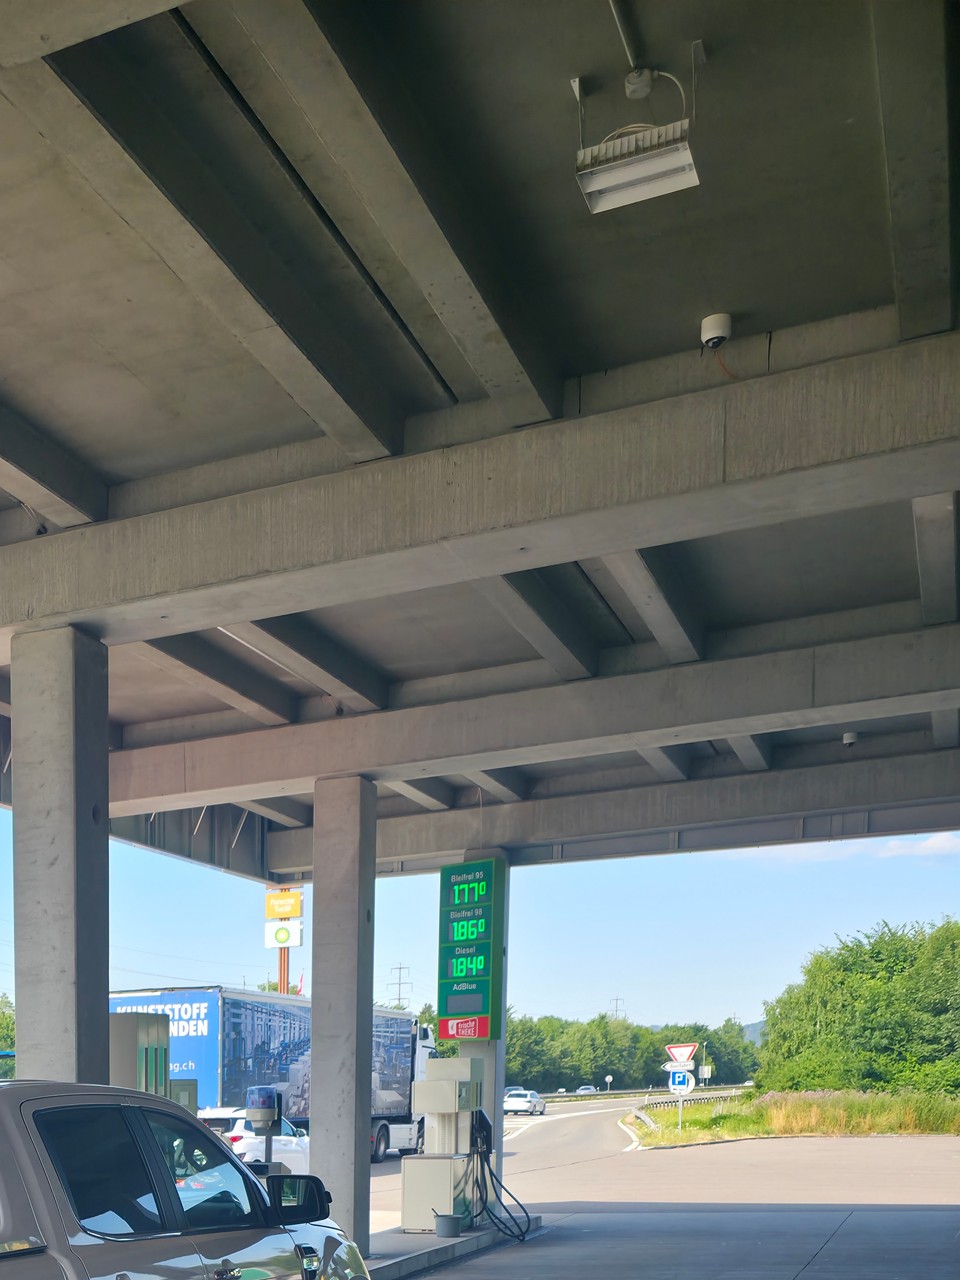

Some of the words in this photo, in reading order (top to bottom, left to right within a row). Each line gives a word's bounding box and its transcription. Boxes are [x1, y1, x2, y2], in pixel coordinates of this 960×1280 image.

[451, 872, 474, 882] Bleifrei
[475, 871, 484, 879] 95
[450, 909, 474, 919] Bleifrei
[474, 908, 483, 916] 98
[455, 946, 476, 955] Diesel
[452, 982, 477, 991] AdBlue
